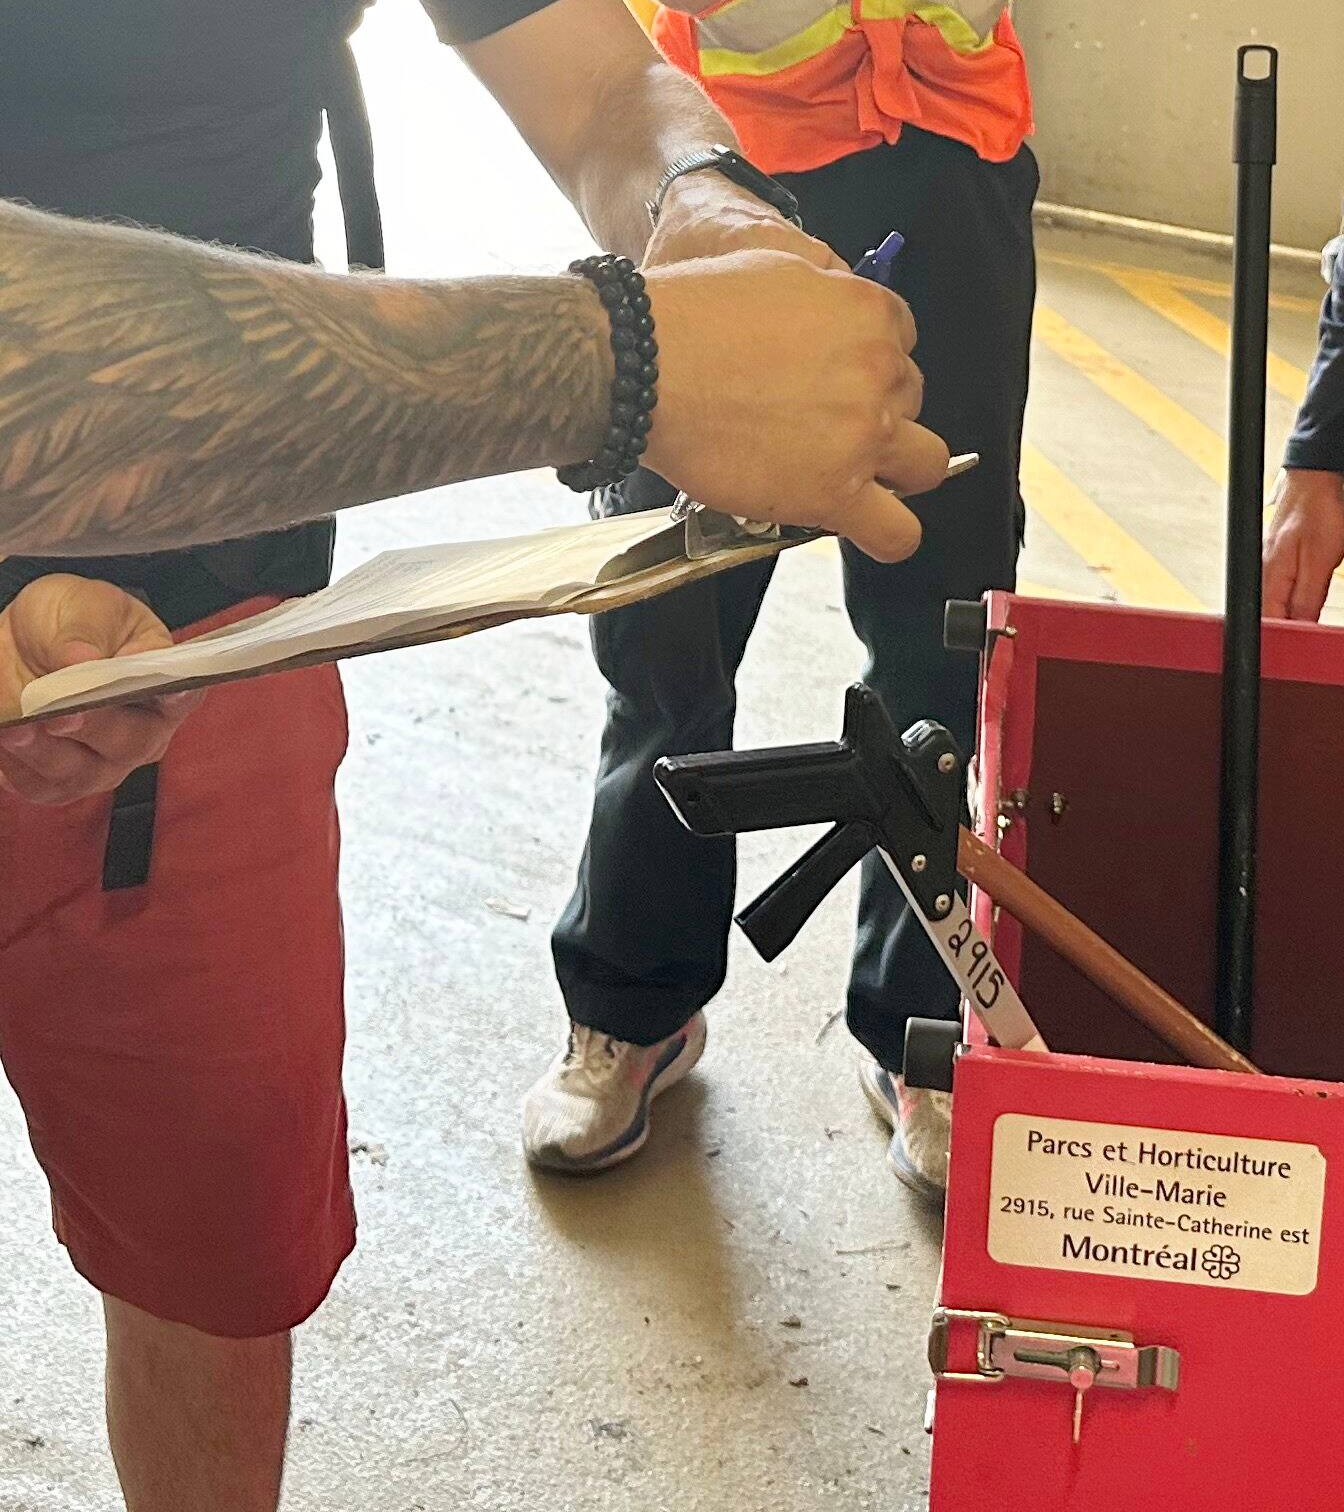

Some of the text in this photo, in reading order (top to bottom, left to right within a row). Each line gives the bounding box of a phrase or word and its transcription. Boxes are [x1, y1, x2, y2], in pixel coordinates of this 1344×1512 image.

[948, 919, 1004, 1009] 2915
[1027, 1130, 1292, 1179] Parcs et Horticulture
[1085, 1172, 1228, 1208] Ville-Marie
[1000, 1196, 1310, 1245] 2915, rue Sainte-Catherine est
[1061, 1234, 1198, 1272] Montréal
